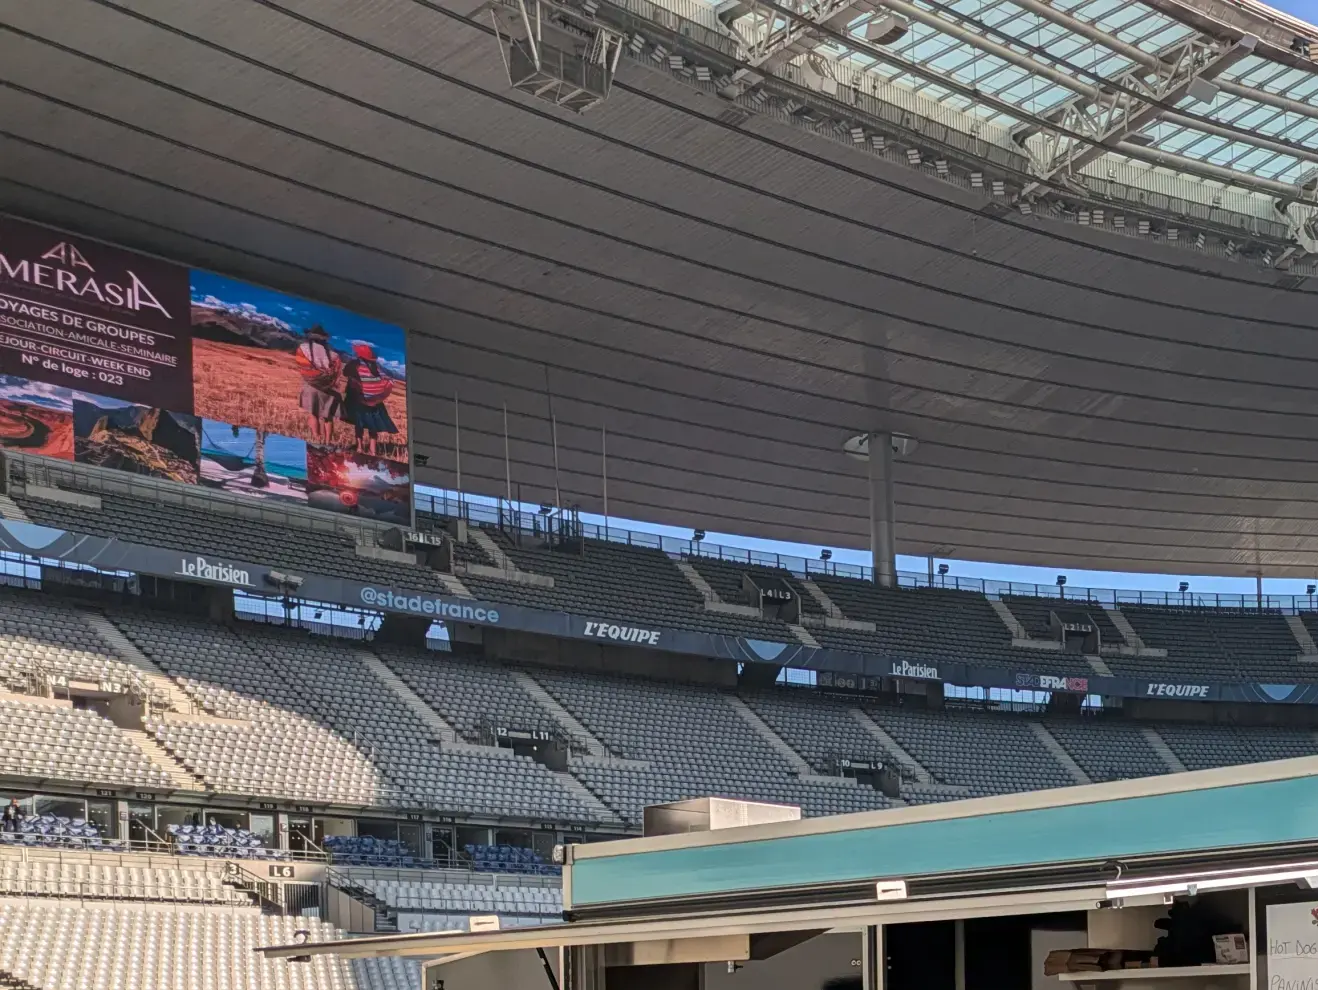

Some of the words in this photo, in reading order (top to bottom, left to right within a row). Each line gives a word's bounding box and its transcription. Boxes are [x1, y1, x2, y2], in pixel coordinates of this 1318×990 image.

[62, 314, 83, 328] DE
[86, 319, 155, 346] GROUPES
[42, 359, 59, 371] de
[62, 361, 89, 378] loge
[99, 372, 124, 386] 023
[127, 367, 151, 378] END
[182, 559, 195, 575] Le
[197, 557, 249, 585] Parisien
[360, 587, 499, 623] @stadefrance
[893, 662, 902, 675] Le
[902, 660, 938, 679] Parisien
[1269, 937, 1291, 955] HOT
[1296, 939, 1317, 955] DOG
